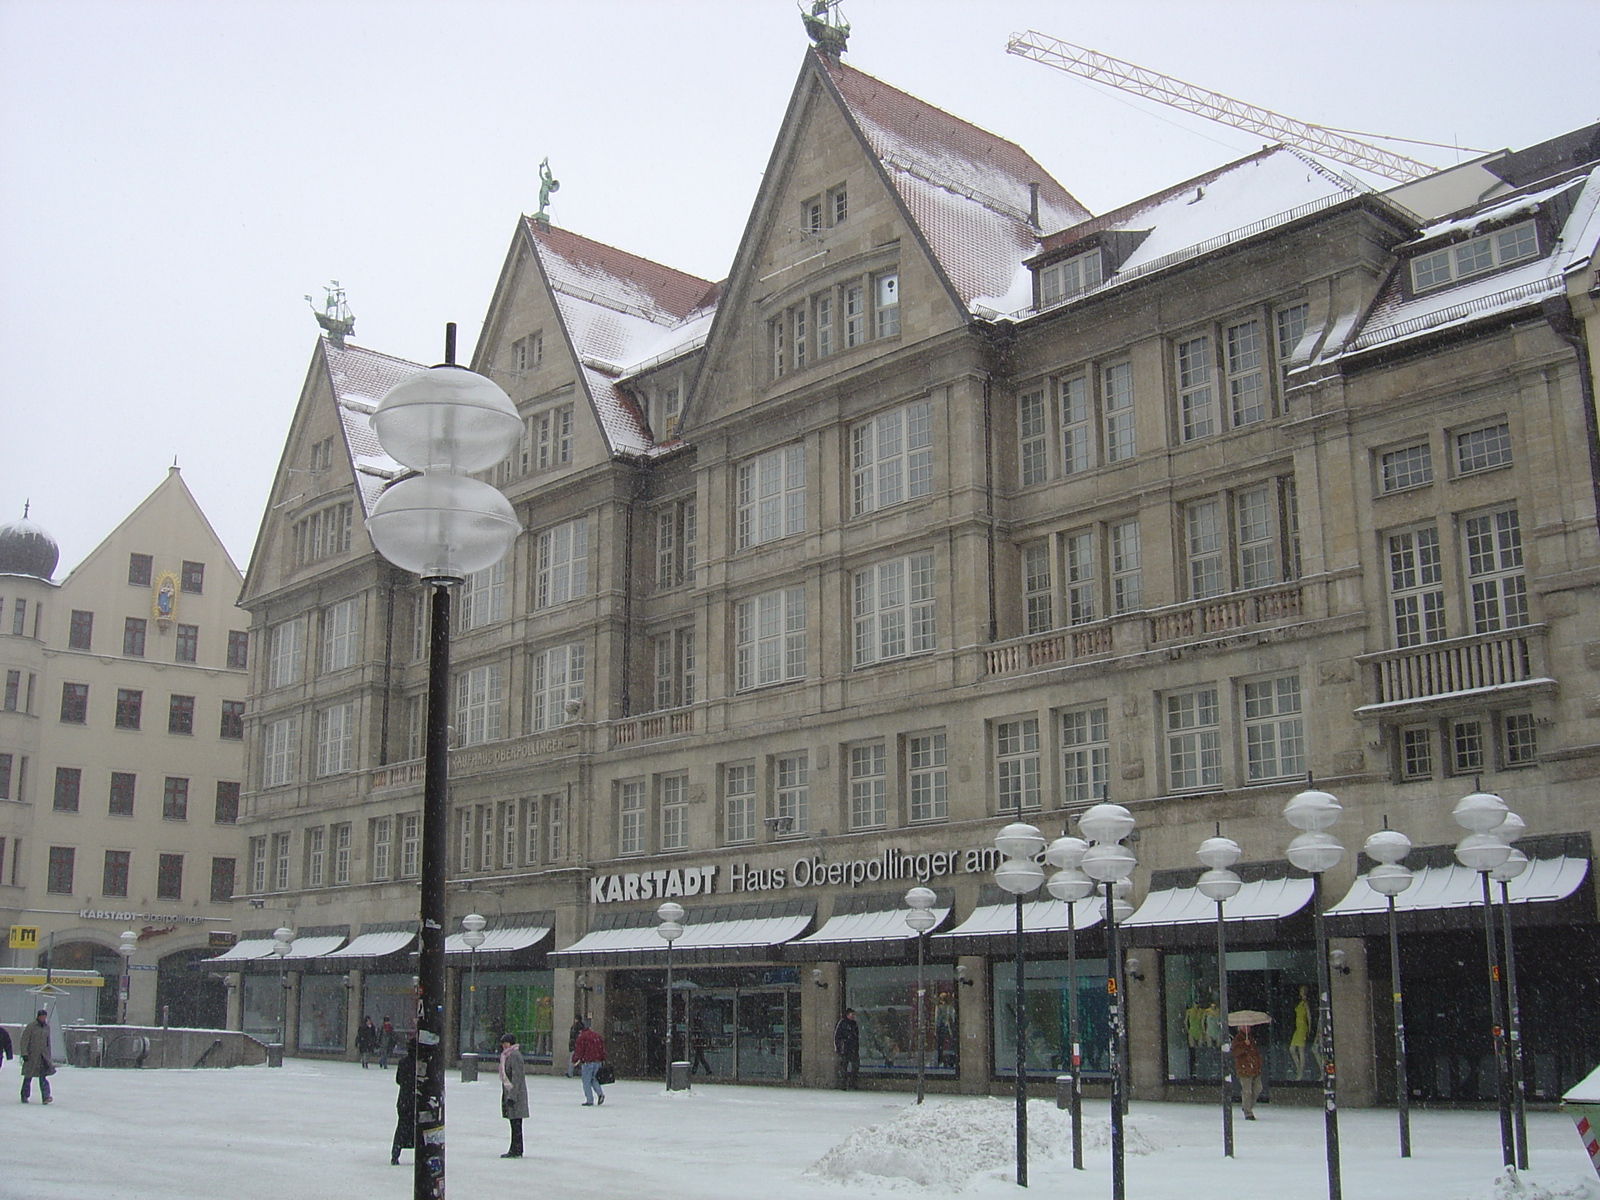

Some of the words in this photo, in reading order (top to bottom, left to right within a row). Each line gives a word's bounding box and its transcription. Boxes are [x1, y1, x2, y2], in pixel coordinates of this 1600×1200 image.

[495, 738, 563, 762] OBERPOLLINGER
[590, 865, 717, 904] KARSTADT
[730, 863, 786, 893] Haus
[792, 848, 961, 887] Oberpollinger
[79, 909, 137, 921] KARSTADT
[141, 913, 206, 925] Oberpollinger
[65, 977, 93, 985] Gewinne
